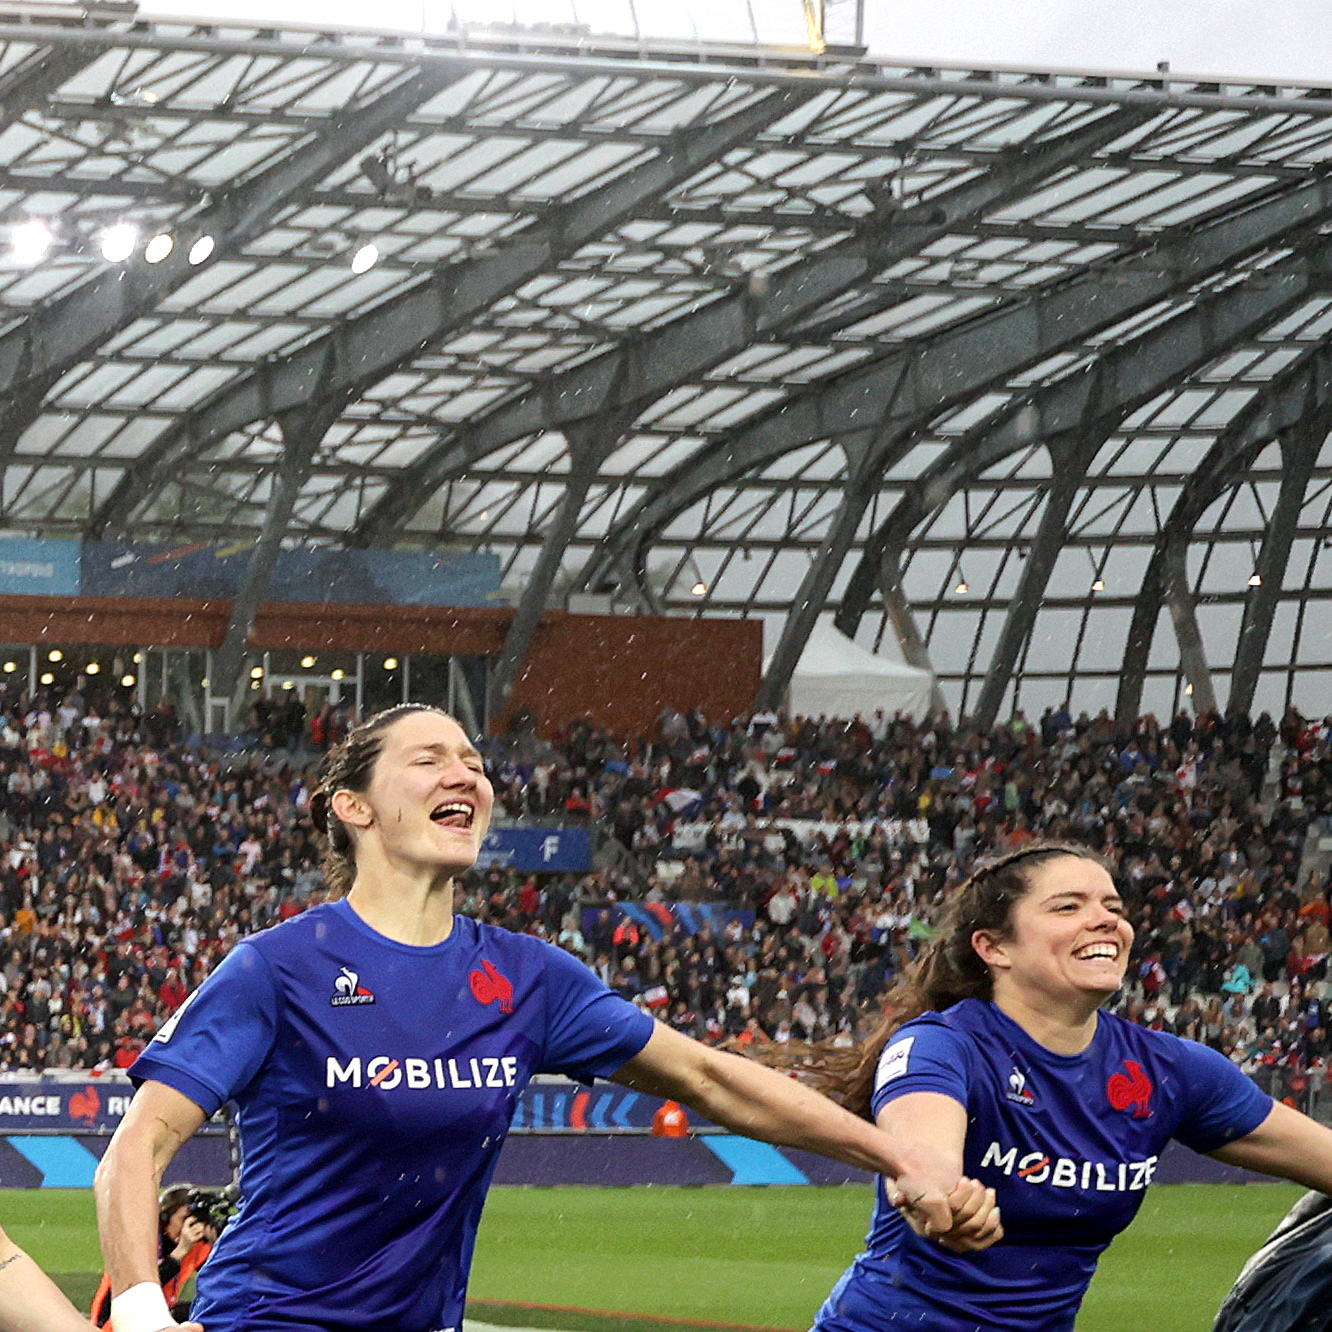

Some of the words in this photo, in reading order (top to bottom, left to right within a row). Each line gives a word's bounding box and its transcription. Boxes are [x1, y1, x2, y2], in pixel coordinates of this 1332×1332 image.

[543, 836, 560, 862] F
[326, 1056, 517, 1090] MOBILIZE
[980, 1141, 1158, 1192] MOBILIZE
